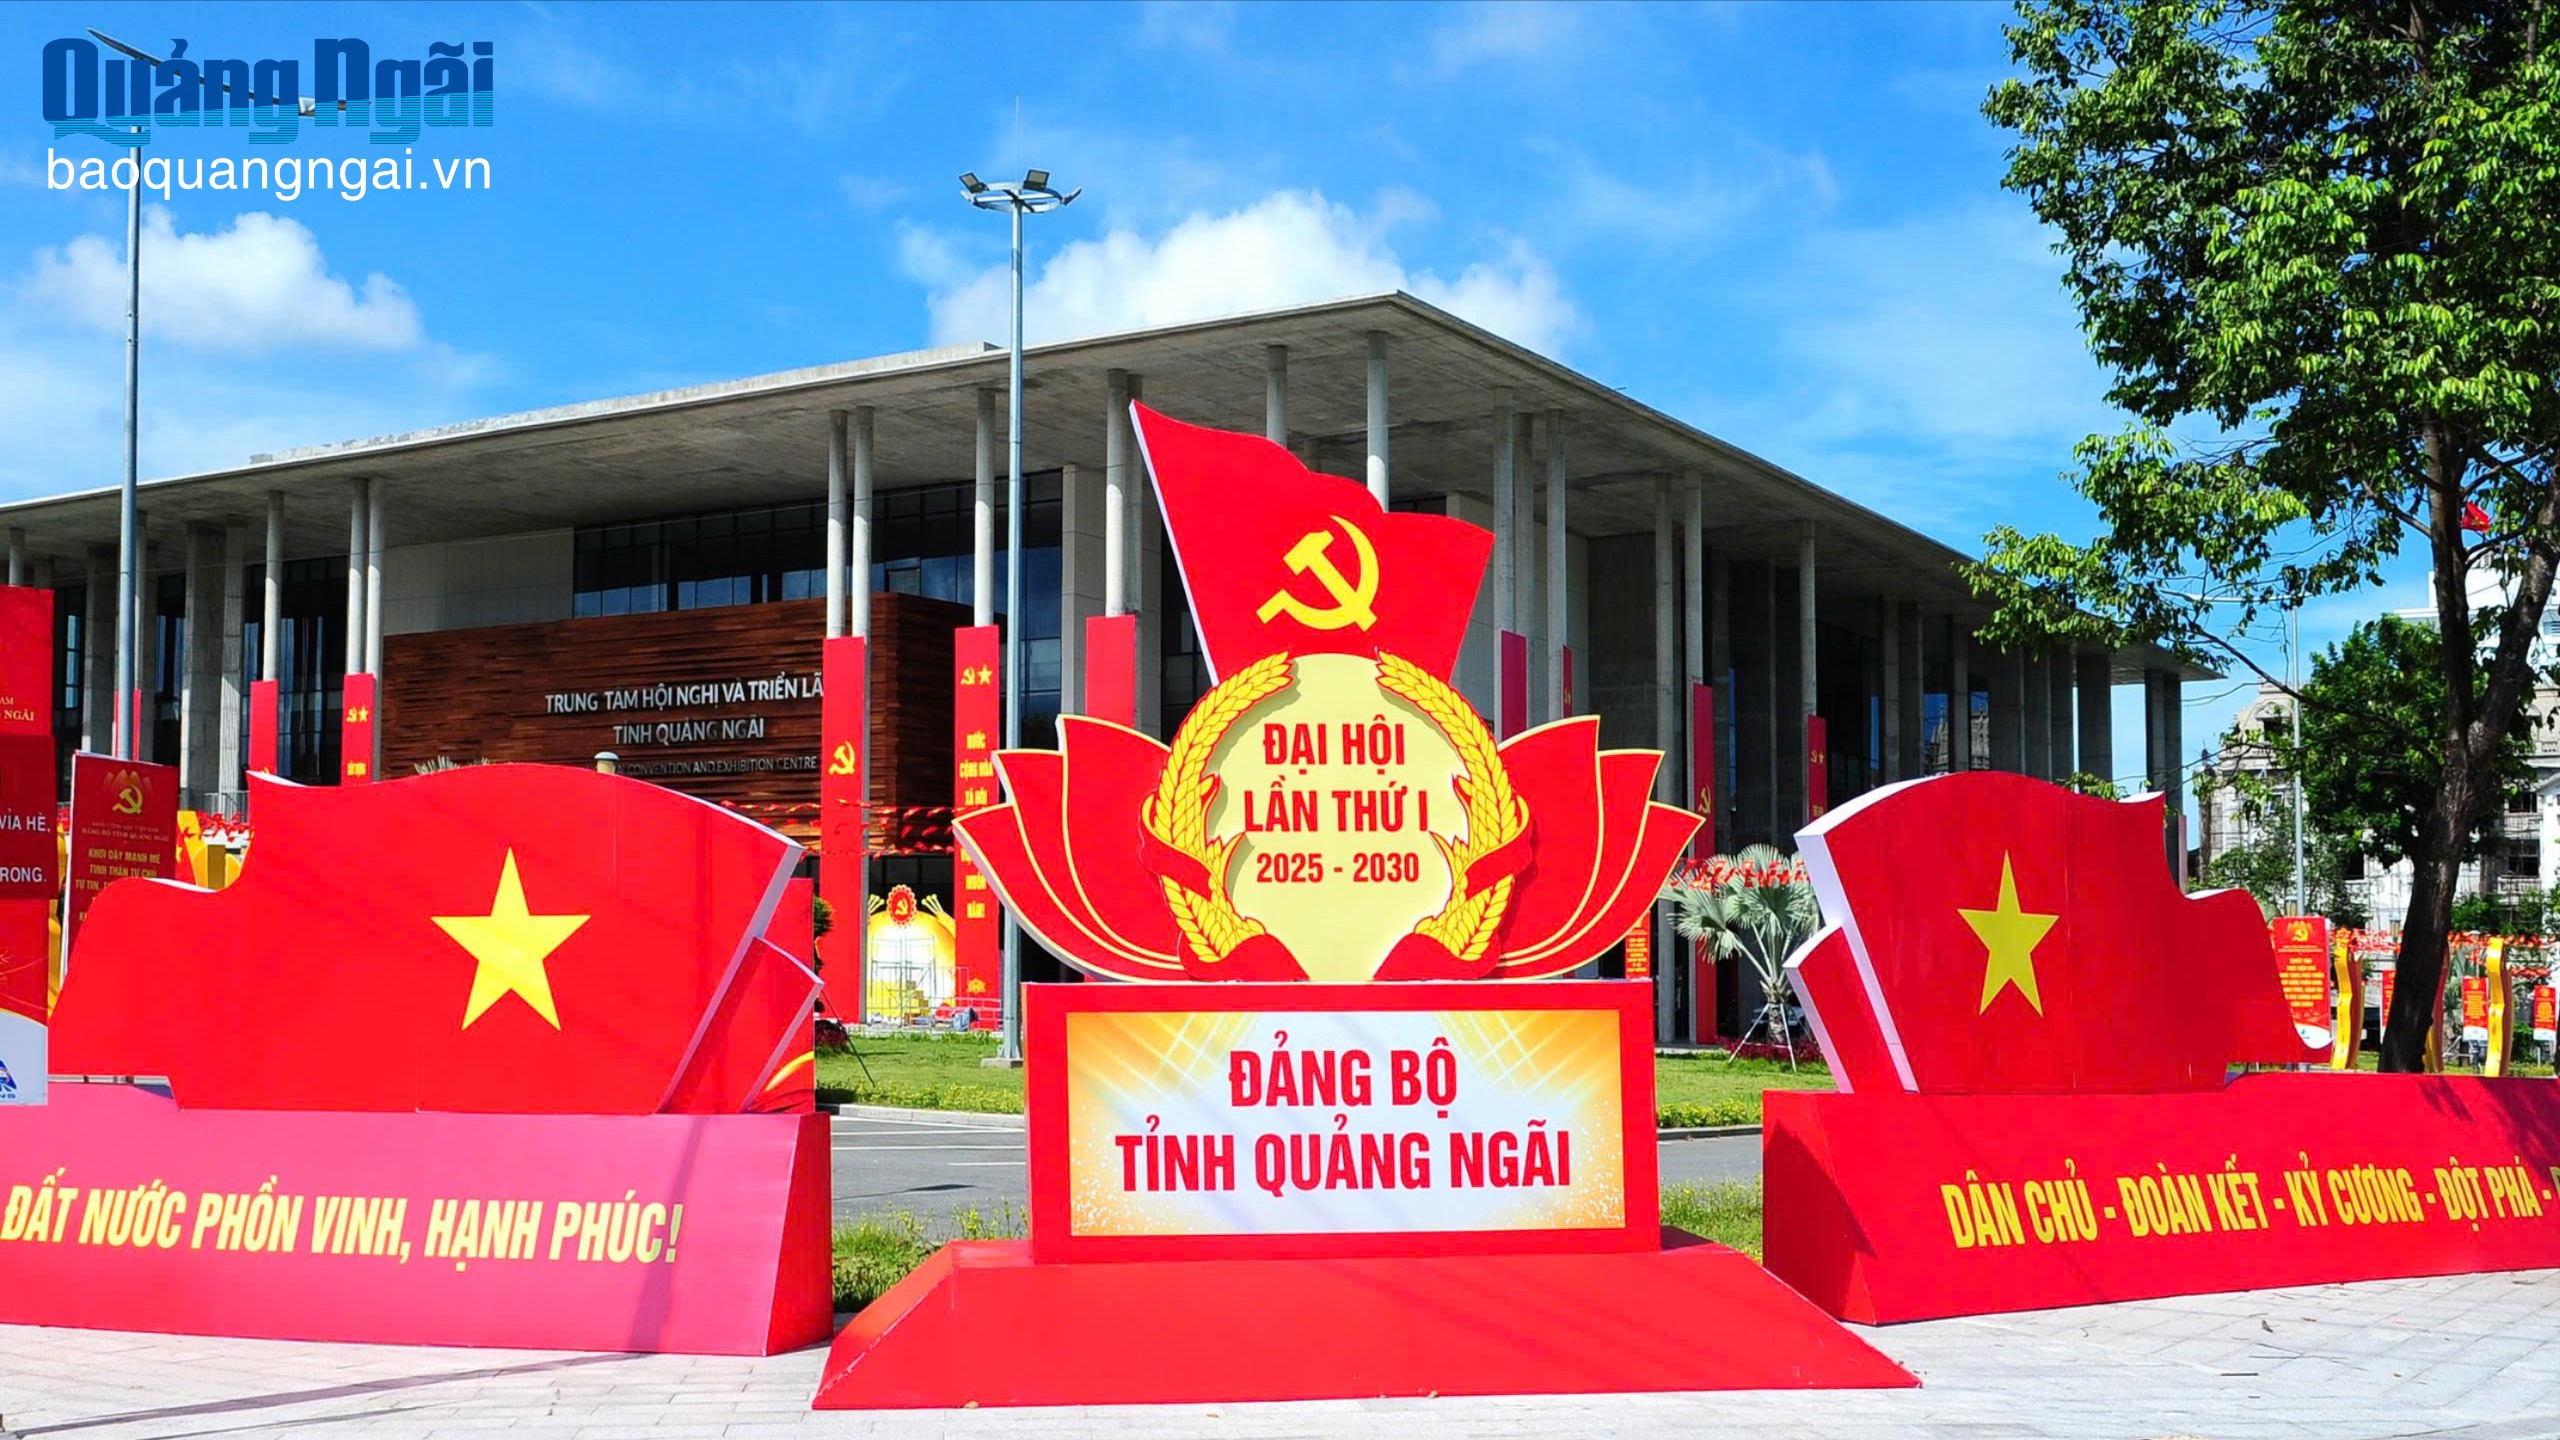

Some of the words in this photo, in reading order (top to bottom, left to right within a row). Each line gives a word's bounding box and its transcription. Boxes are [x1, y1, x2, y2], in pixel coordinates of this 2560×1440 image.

[545, 692, 599, 714] TRUNG
[604, 686, 639, 710] TÂM
[643, 683, 672, 711] HỘI
[676, 684, 718, 709] NGHỊ
[722, 677, 746, 702] VÀ
[748, 671, 797, 701] TRIỂN
[656, 716, 718, 746] QUẢNG
[722, 714, 764, 739] NGÃI
[1263, 723, 1327, 775] ĐẠI
[1342, 714, 1405, 775] HỘI
[693, 760, 715, 773] AND
[717, 758, 774, 772] EXHIBITION
[777, 756, 817, 769] CENTRE
[1244, 775, 1318, 832] LẦN
[1331, 781, 1408, 832] THỨ
[1418, 790, 1428, 832] I
[1256, 852, 1324, 883] 2025
[1353, 852, 1419, 883] 2030
[1228, 1030, 1372, 1106] ĐẢNG
[1391, 1037, 1457, 1119] BỘ
[1115, 1114, 1235, 1192] TỈNH
[1255, 1113, 1431, 1197] QUẢNG
[1450, 1118, 1571, 1188] NGÃI
[0, 1167, 78, 1243] ĐẤT
[78, 1179, 187, 1249] NƯỚC
[191, 1175, 304, 1252] PHỒN
[311, 1196, 411, 1264] VINH,
[424, 1199, 543, 1272] HẠNH
[549, 1190, 683, 1263] PHÚC!
[1941, 1172, 2026, 1249] DÂN
[2023, 1158, 2099, 1242] CHỦ
[2116, 1163, 2212, 1237] ĐOÀN
[2209, 1154, 2269, 1230] KẾT
[2283, 1151, 2329, 1226] KỶ
[2327, 1163, 2425, 1224] CƯƠNG
[2433, 1156, 2488, 1232] ĐỘT
[2488, 1155, 2543, 1218] PHÁ
